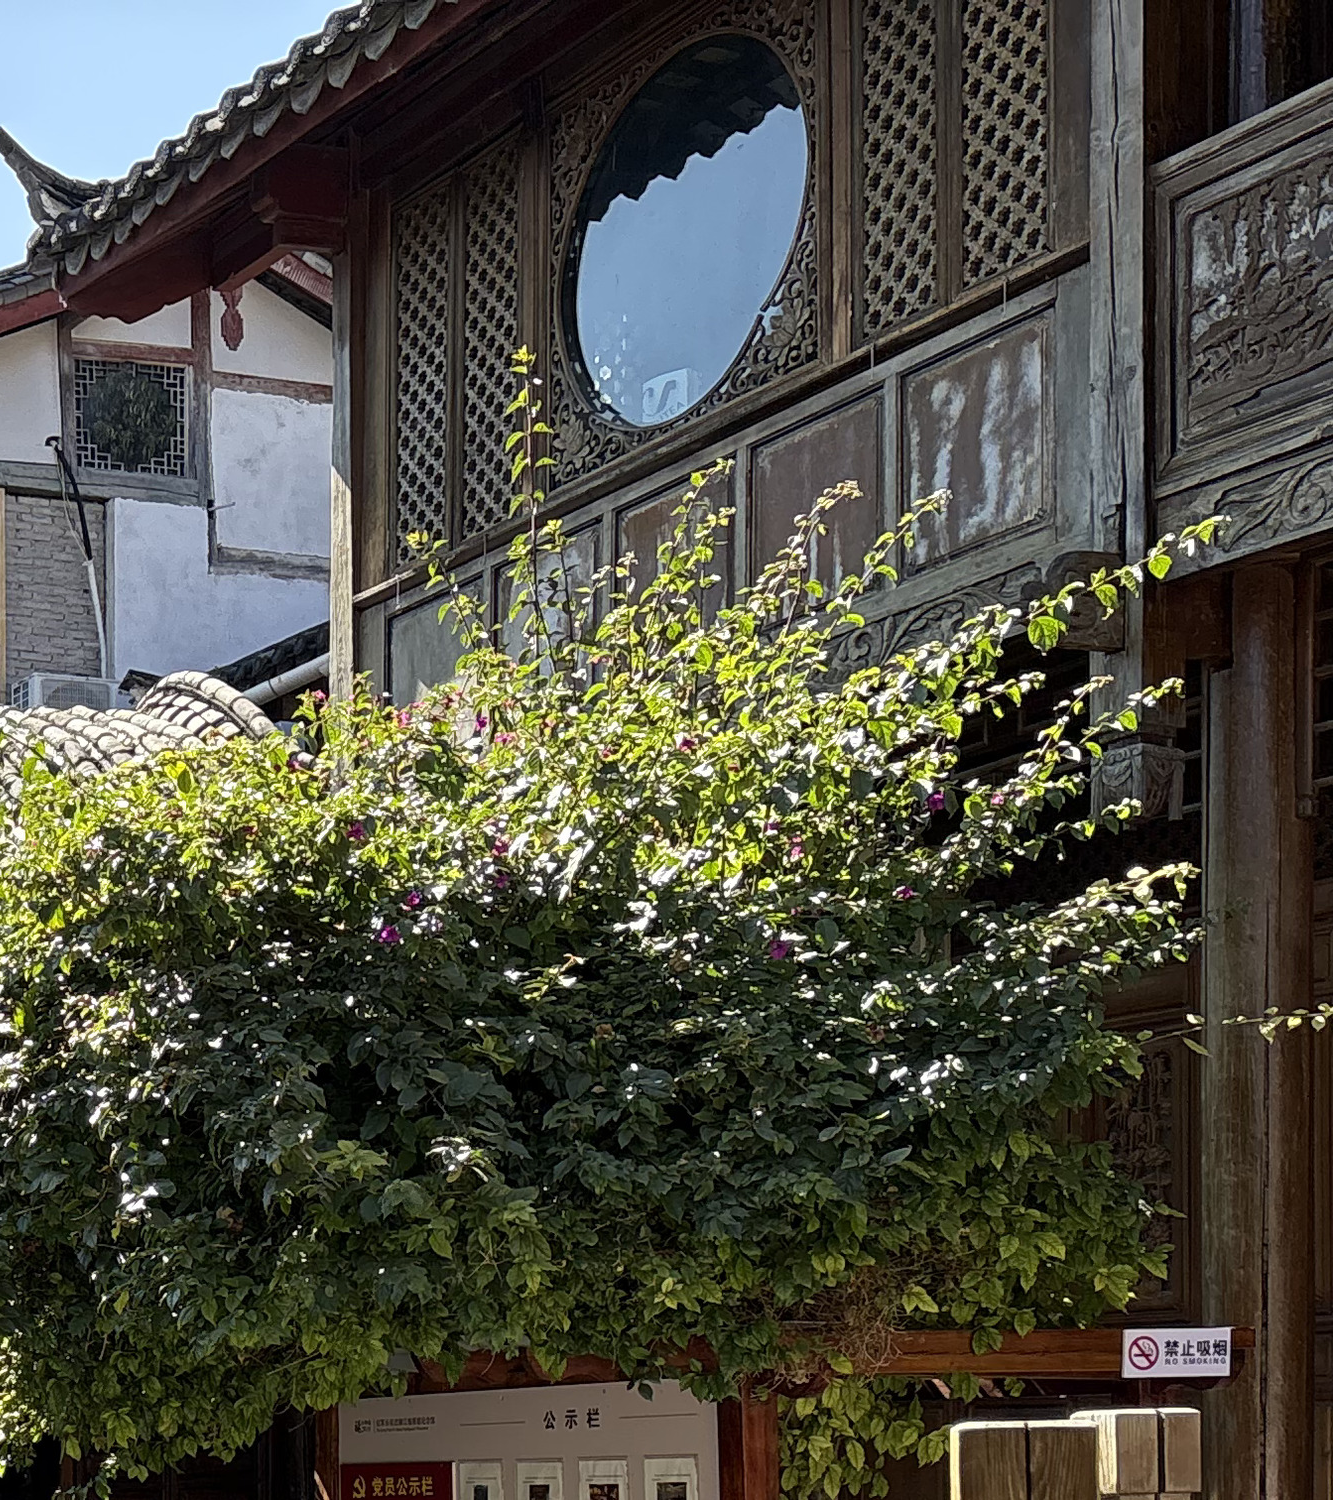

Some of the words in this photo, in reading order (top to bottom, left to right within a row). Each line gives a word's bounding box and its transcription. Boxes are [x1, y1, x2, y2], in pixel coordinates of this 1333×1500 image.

[1164, 1339, 1228, 1357] 禁止吸烟
[1164, 1358, 1179, 1366] NO
[1182, 1357, 1227, 1365] SMOKING
[543, 1407, 602, 1431] 公示栏
[371, 1474, 434, 1499] 党员公示栏
